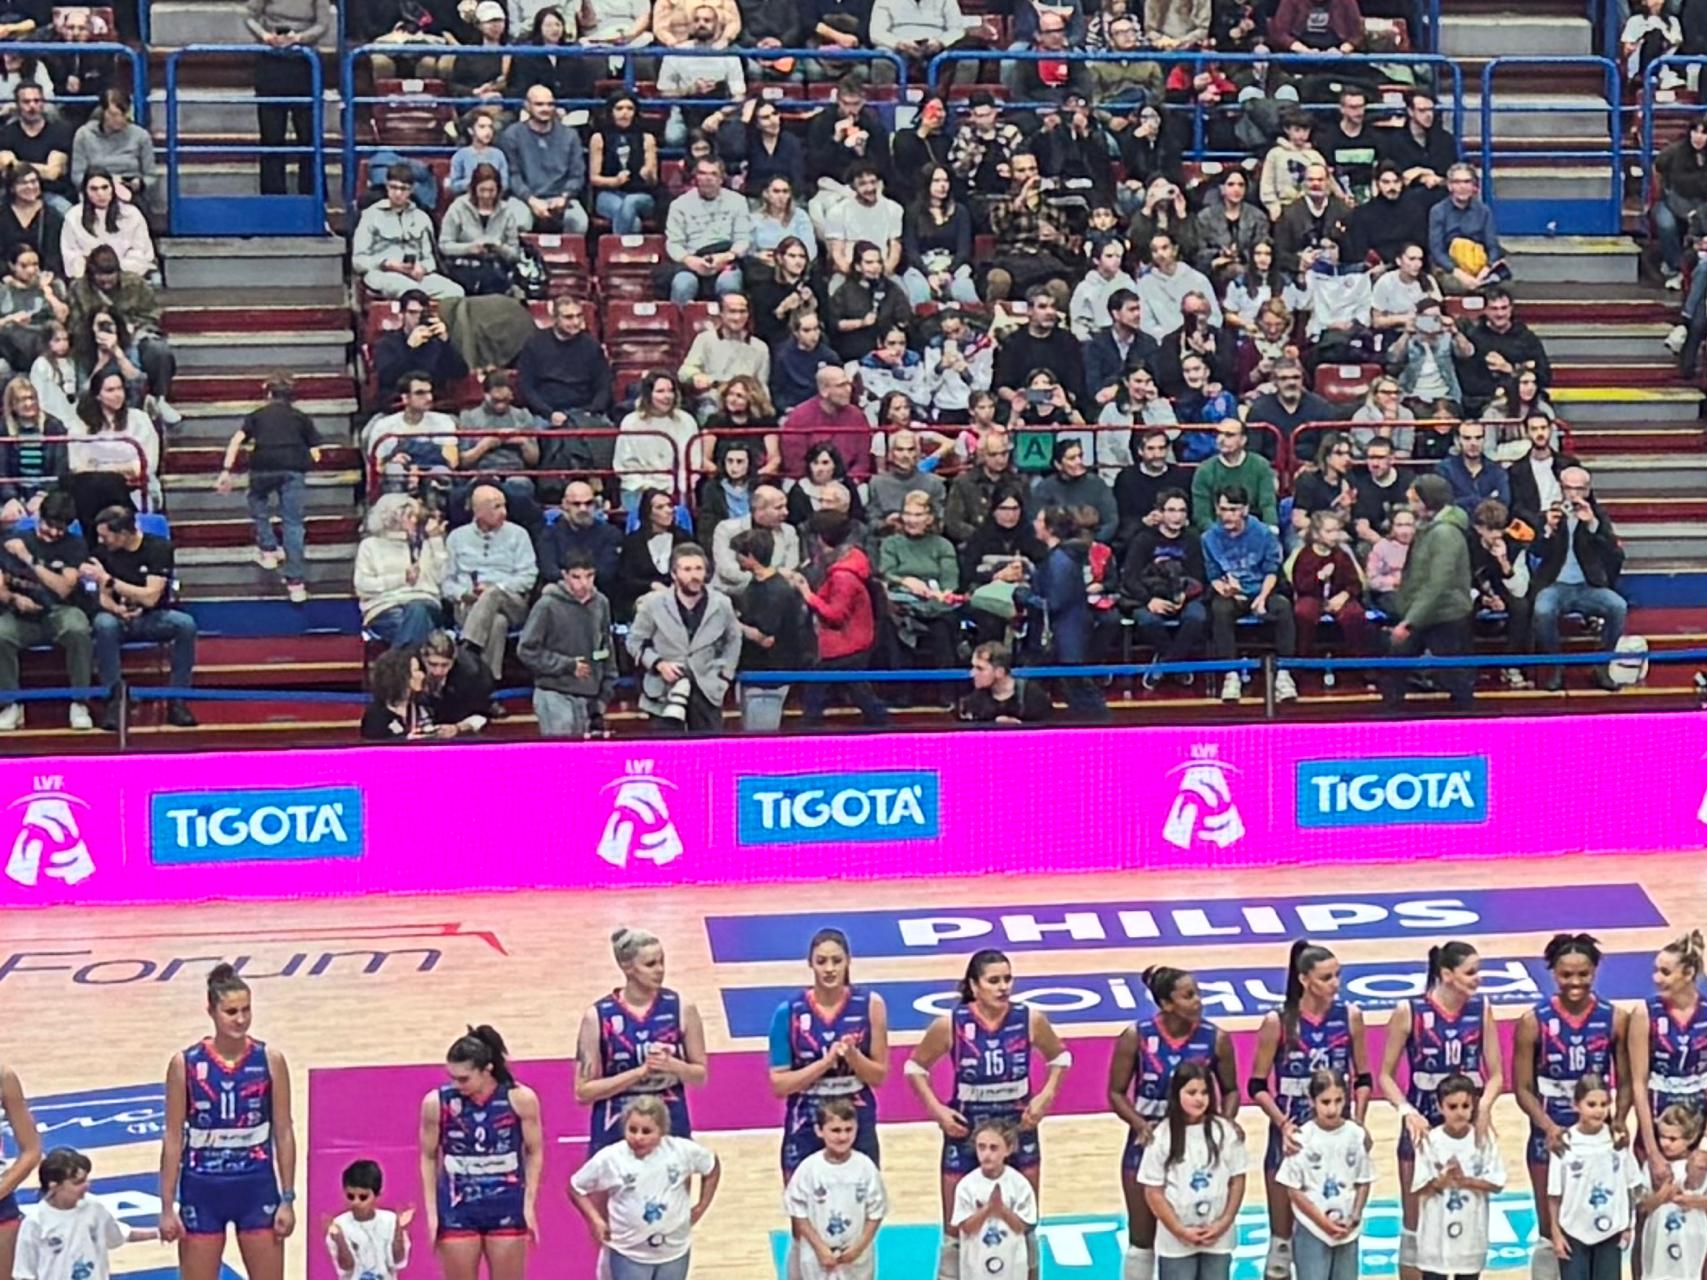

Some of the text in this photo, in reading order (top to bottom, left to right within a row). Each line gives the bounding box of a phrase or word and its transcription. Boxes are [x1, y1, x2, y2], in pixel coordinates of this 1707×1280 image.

[1023, 440, 1046, 461] A
[899, 899, 1480, 947] PHILIPS
[0, 947, 442, 985] Forum
[1444, 1038, 1462, 1066] 10
[1677, 1045, 1689, 1070] 7
[220, 1092, 236, 1119] 11
[474, 1128, 487, 1152] 2
